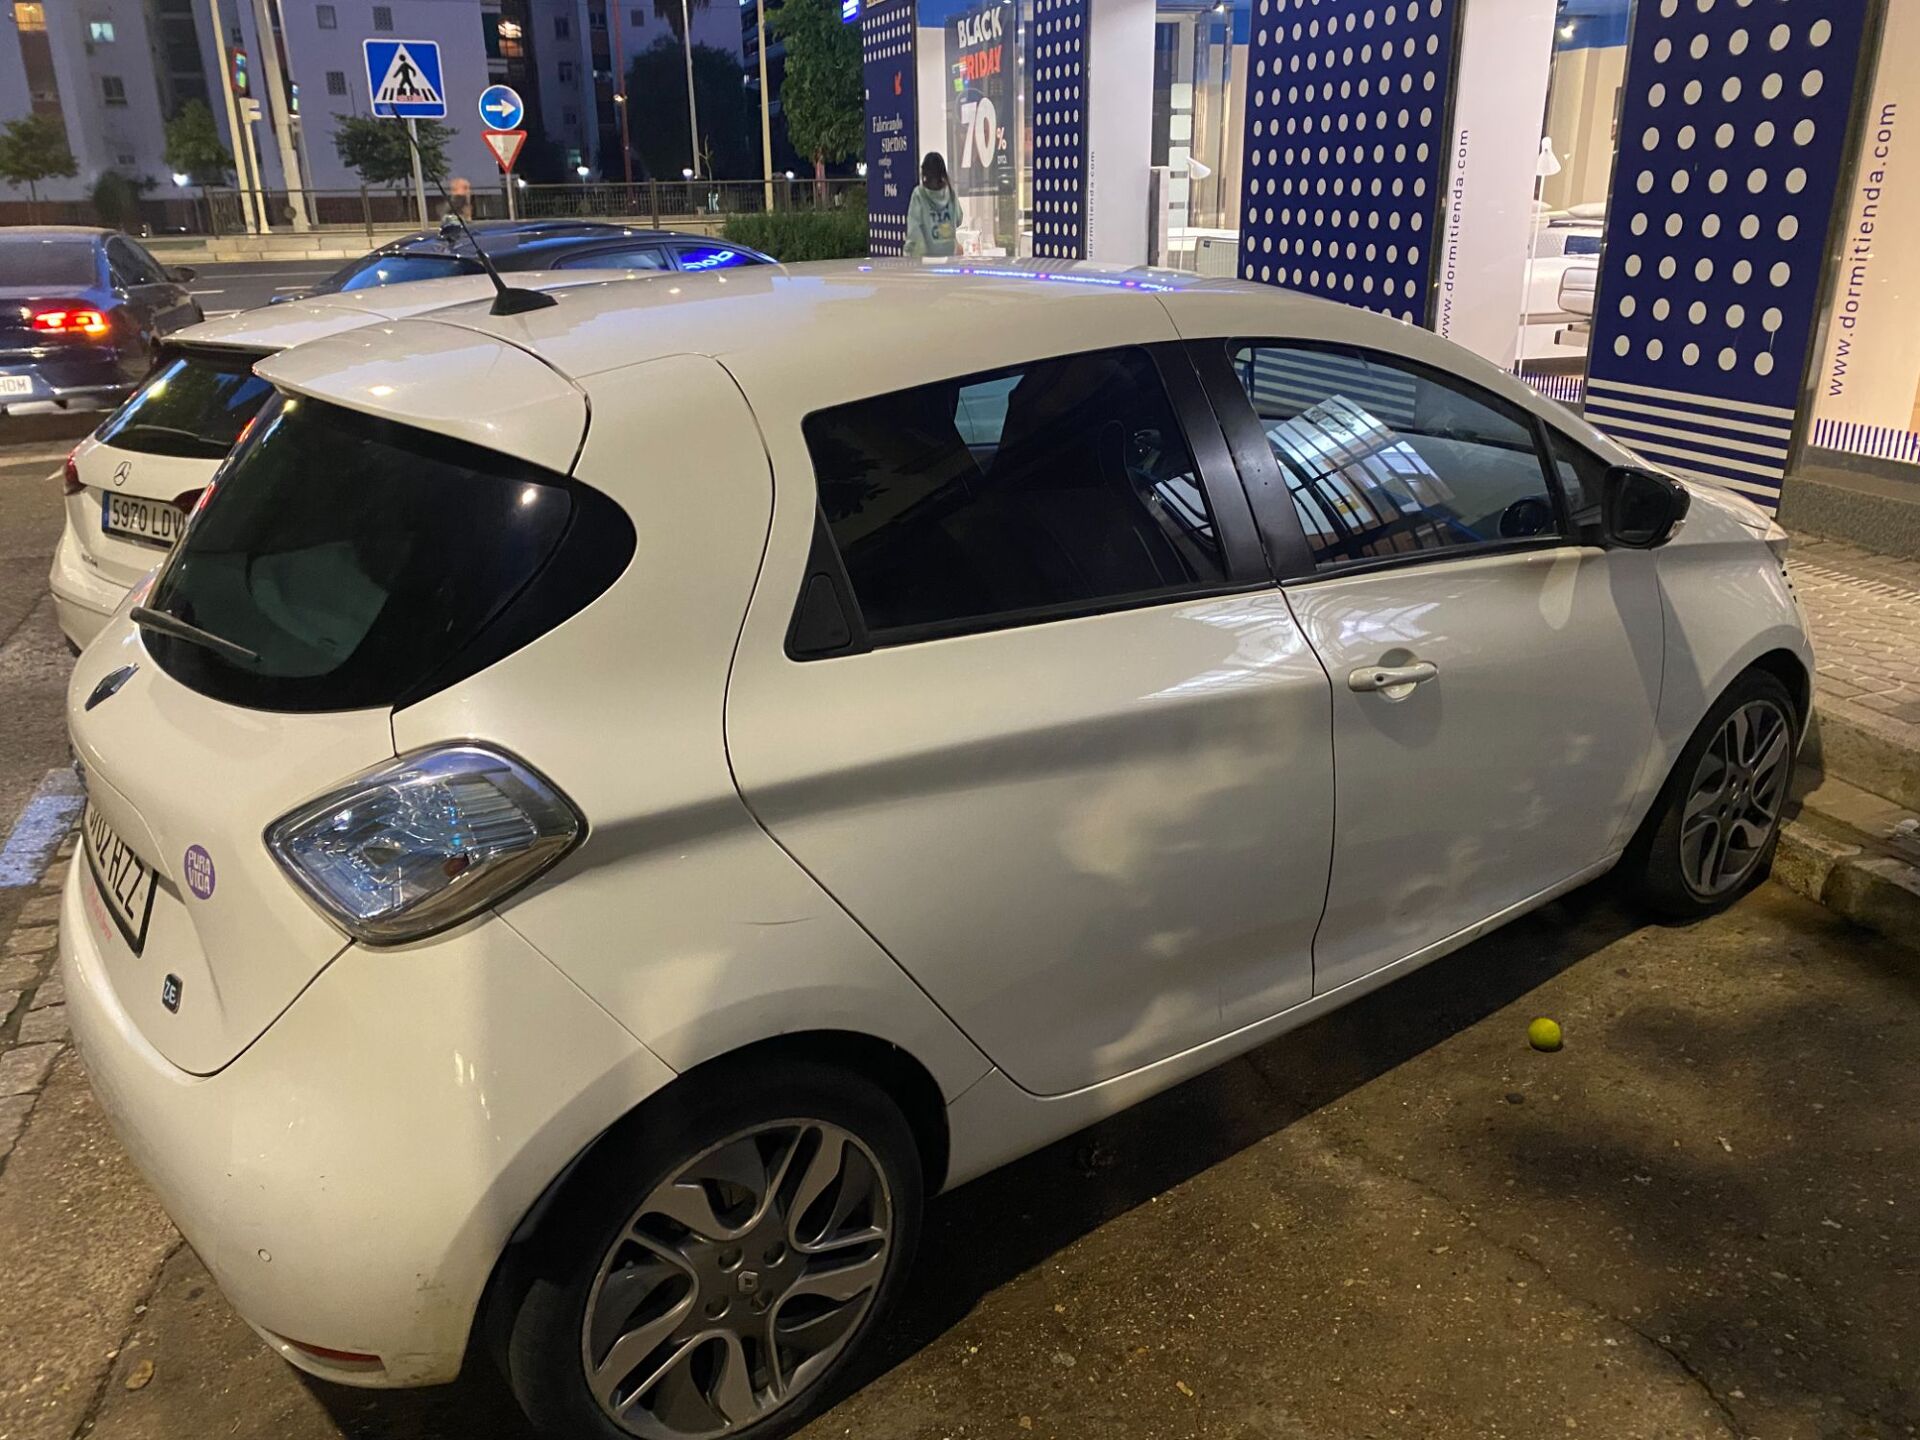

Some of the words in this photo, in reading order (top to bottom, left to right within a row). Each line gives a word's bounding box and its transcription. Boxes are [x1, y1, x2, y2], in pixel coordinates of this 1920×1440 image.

[957, 6, 1002, 49] BLACK
[960, 45, 1002, 81] FRIDAY
[1828, 103, 1897, 397] www.dormitienda.com
[112, 498, 148, 532] 5970
[108, 836, 145, 920] HZZ
[187, 849, 211, 875] PURA
[187, 873, 211, 895] VIDA
